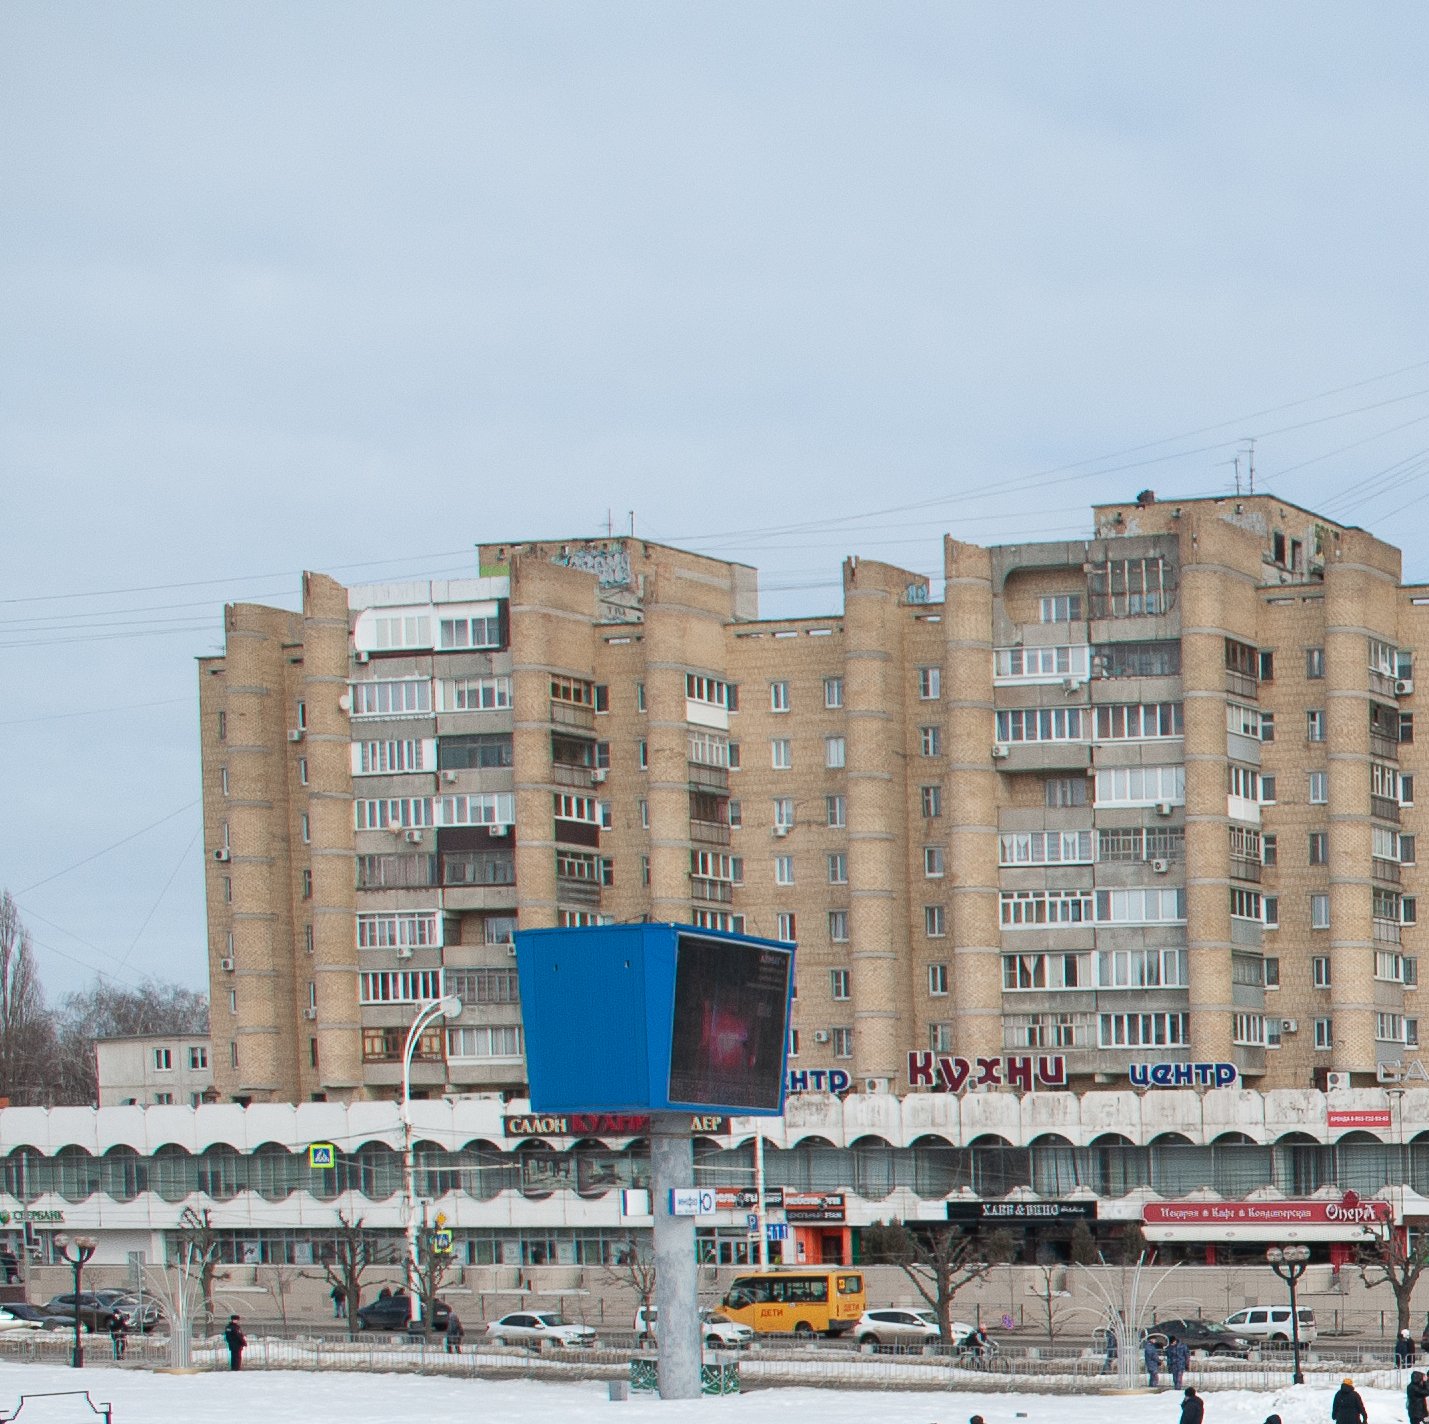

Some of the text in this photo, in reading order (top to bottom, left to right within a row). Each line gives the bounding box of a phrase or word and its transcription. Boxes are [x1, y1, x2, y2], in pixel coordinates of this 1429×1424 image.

[510, 1118, 568, 1133] САЛОН
[843, 1303, 860, 1312] ДЕТИ
[760, 1308, 783, 1318] ДЕТИ
